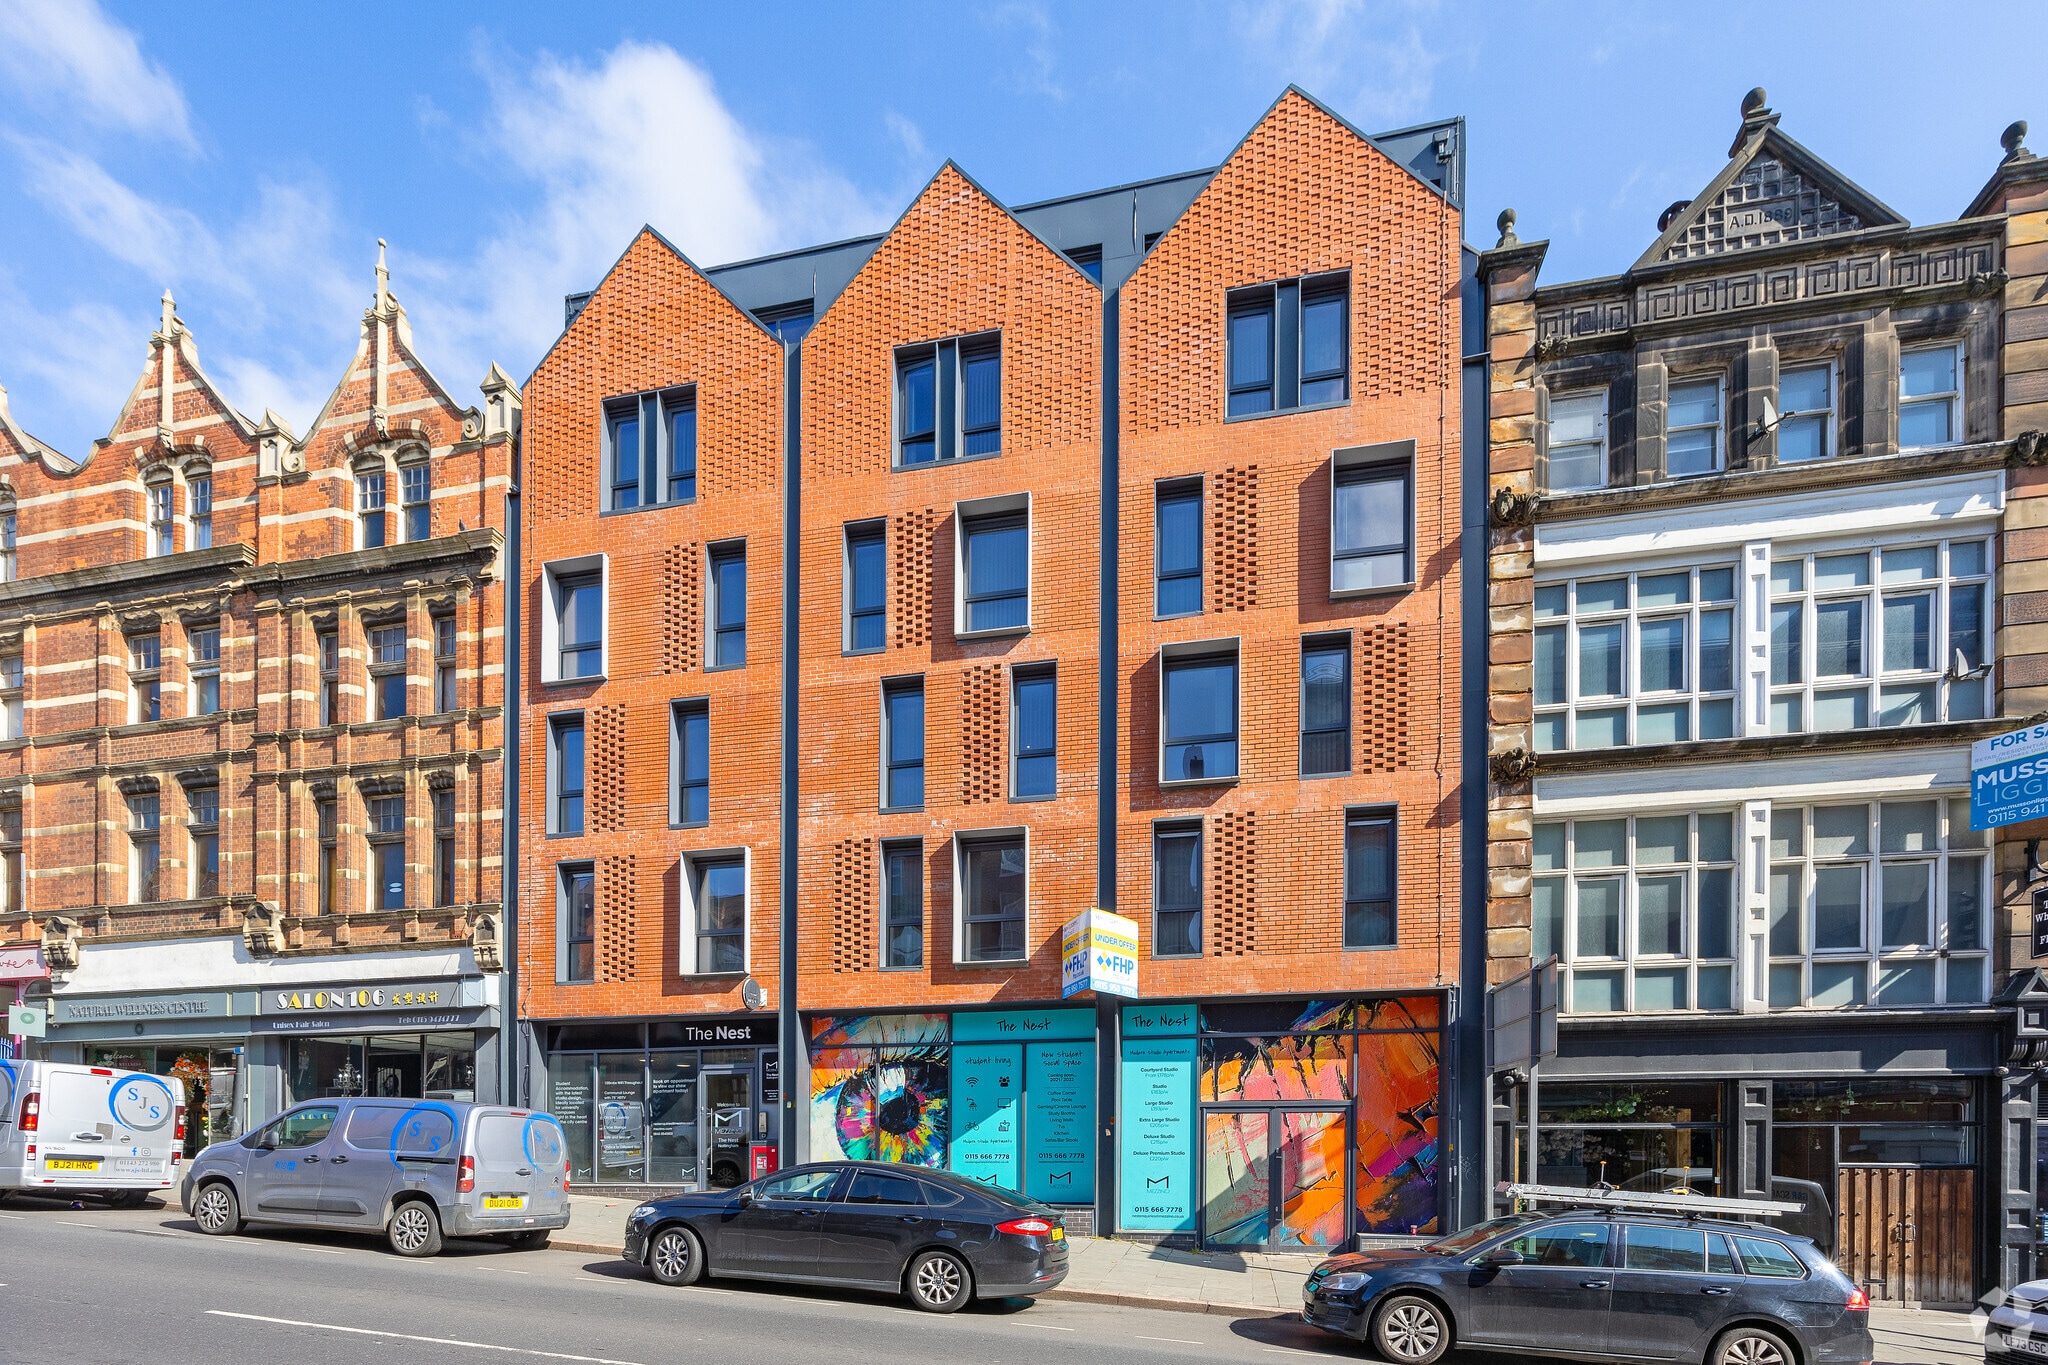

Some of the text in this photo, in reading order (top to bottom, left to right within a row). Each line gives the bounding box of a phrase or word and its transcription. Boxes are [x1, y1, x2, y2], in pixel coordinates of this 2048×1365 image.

[1990, 731, 2027, 751] FOR
[1977, 777, 2048, 807] LIGG
[1987, 803, 2045, 824] 0115 941
[1094, 933, 1136, 951] UNDER OFFER
[1072, 951, 1088, 972] FHP
[1112, 955, 1134, 975] FHP
[1094, 981, 1107, 991] 0115
[1109, 983, 1121, 992] 950
[276, 988, 386, 1009] SALON 106
[68, 1000, 209, 1018] NATURAL WELLNESS CENTRE
[272, 1020, 330, 1029] Unisex Hair Salon
[996, 1017, 1051, 1032] The Nest
[1132, 1012, 1190, 1028] The Nest
[686, 1026, 751, 1040] The Nest
[965, 1056, 1012, 1067] student living
[53, 1161, 93, 1170] BJ21 HNG
[489, 1199, 506, 1208] DU21
[2028, 1341, 2047, 1354] CSC
